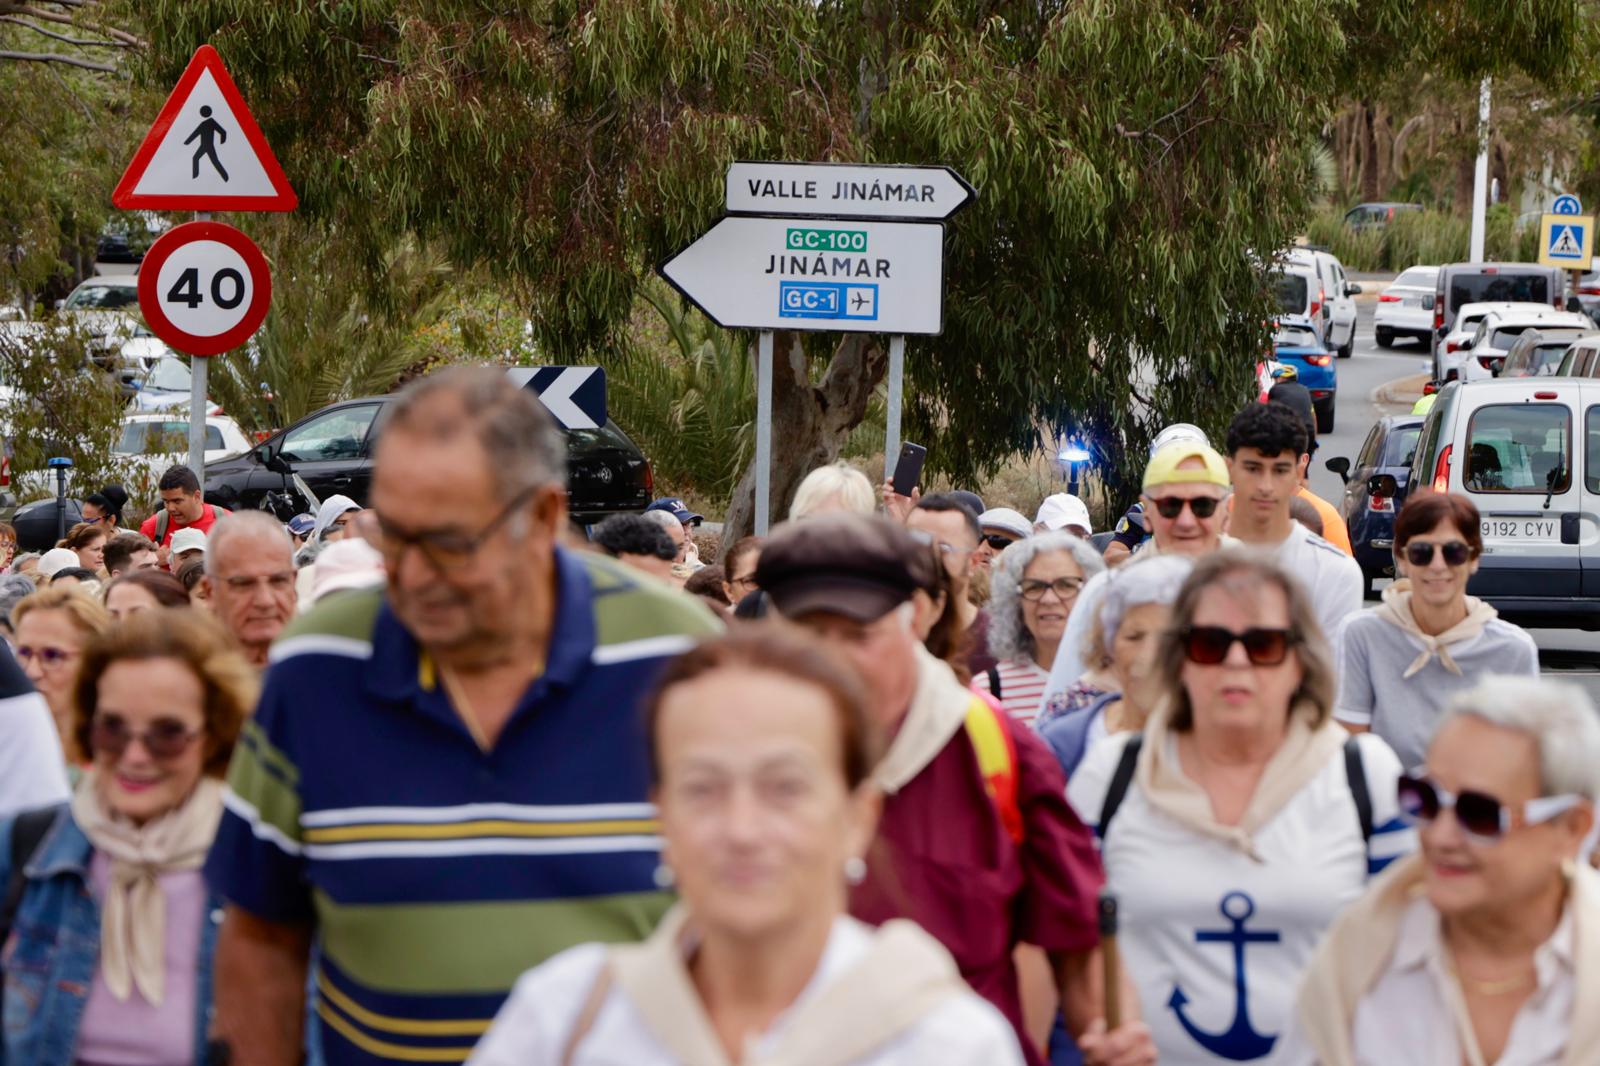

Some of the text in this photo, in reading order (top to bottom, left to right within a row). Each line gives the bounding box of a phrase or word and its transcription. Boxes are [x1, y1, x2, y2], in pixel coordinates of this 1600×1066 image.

[748, 179, 935, 202] VALLE JINÁMAR
[788, 230, 866, 250] GC-100
[765, 252, 891, 278] JINÁMAR
[167, 267, 245, 310] 40
[786, 290, 836, 309] GC-1
[1481, 522, 1554, 537] 9192 CYV
